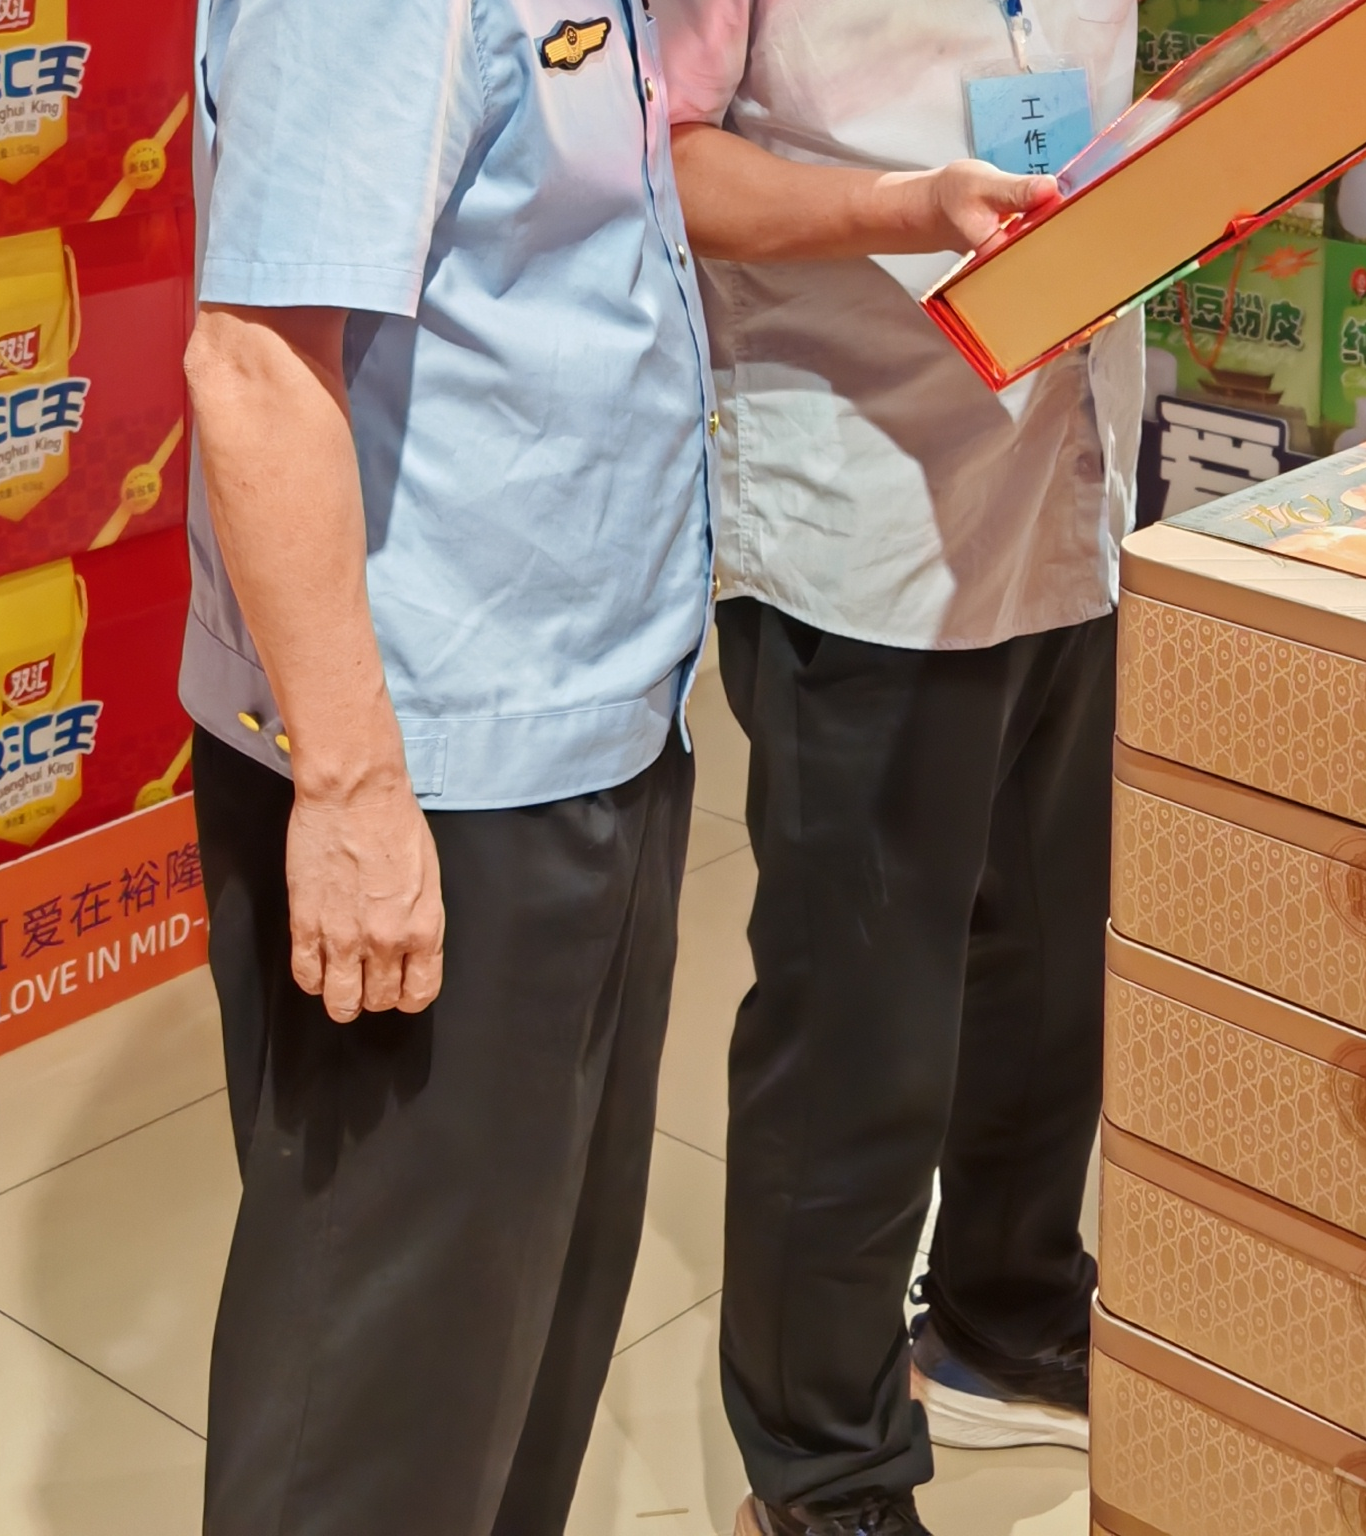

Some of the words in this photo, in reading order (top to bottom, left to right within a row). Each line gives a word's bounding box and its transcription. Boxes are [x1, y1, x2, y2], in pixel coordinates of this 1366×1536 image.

[31, 98, 60, 119] King
[33, 436, 62, 455] King
[9, 660, 50, 700] 双汇
[46, 760, 76, 779] King
[86, 946, 125, 986] IN
